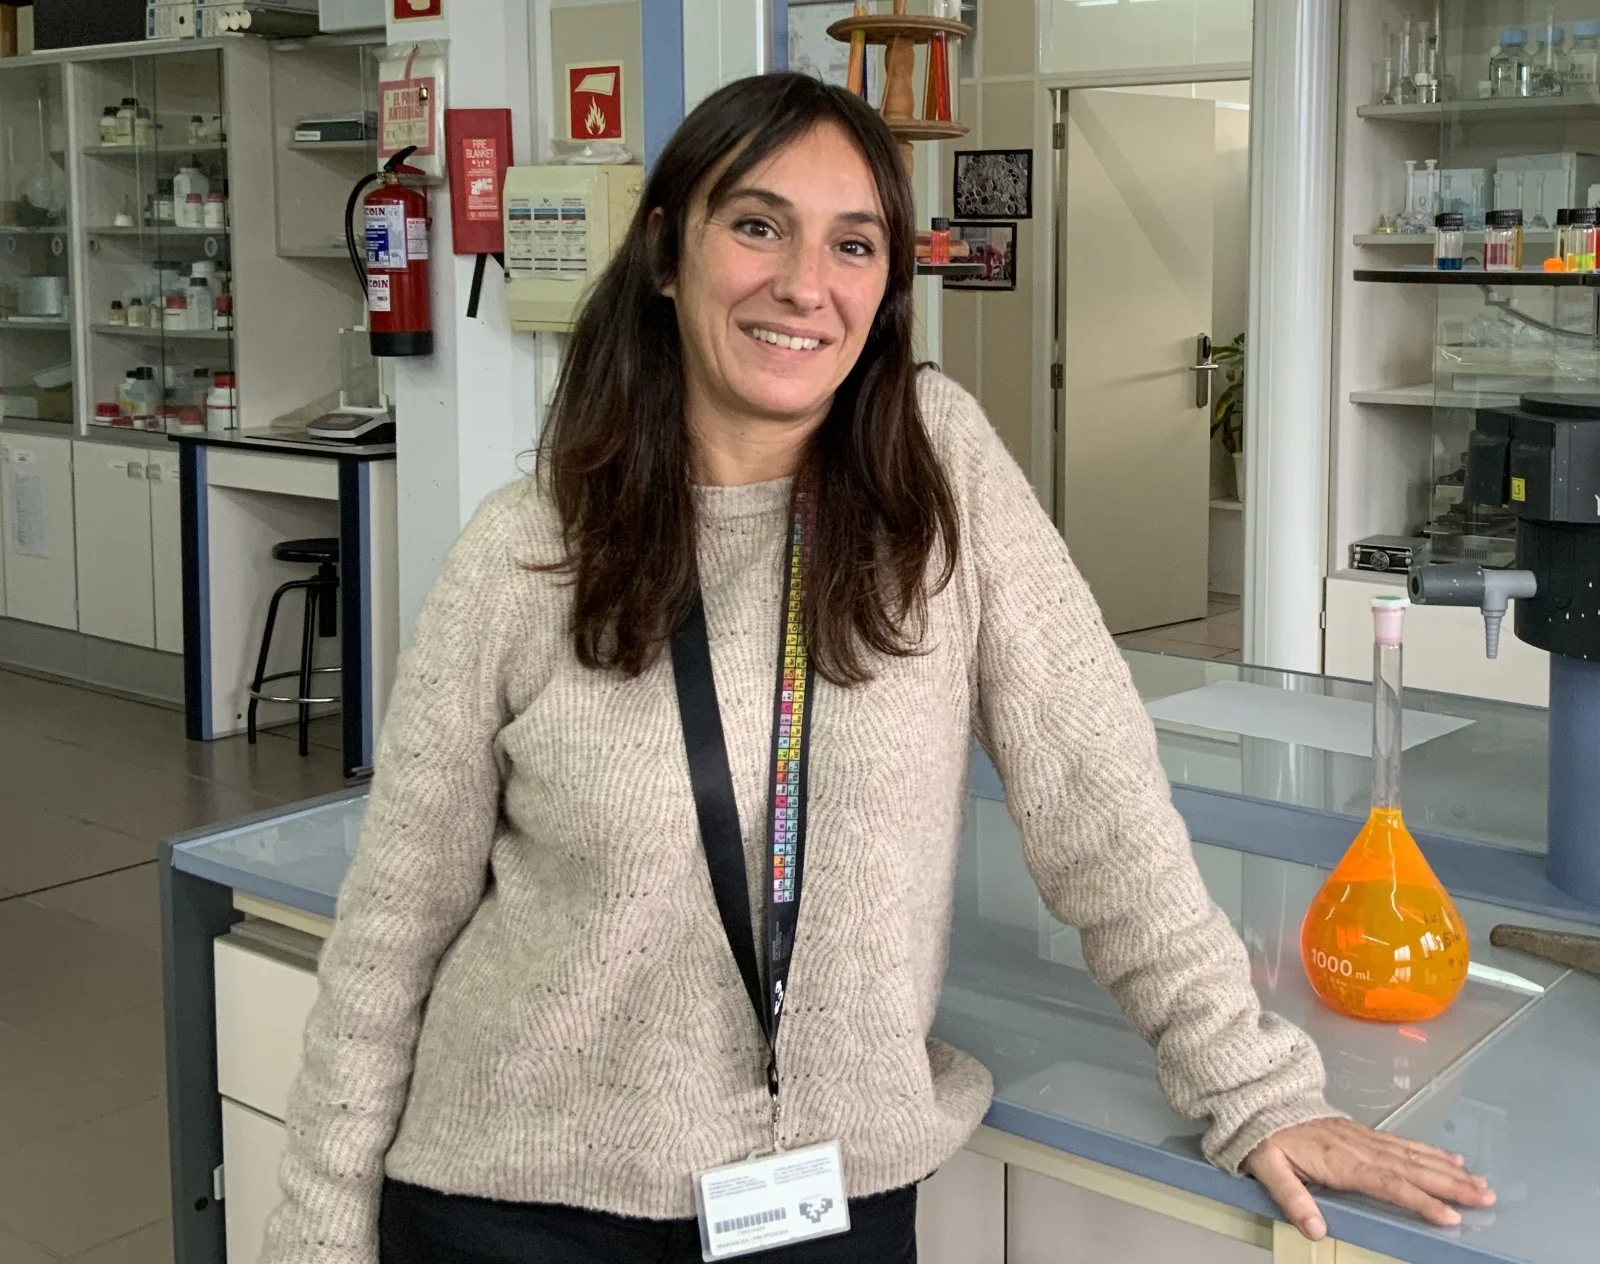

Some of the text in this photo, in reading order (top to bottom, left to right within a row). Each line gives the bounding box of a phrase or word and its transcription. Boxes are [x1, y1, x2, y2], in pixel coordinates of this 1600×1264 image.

[472, 139, 487, 149] FIRE
[465, 148, 494, 159] BLANKET
[1311, 948, 1374, 981] 1000 ml.
[1389, 975, 1398, 984] A
